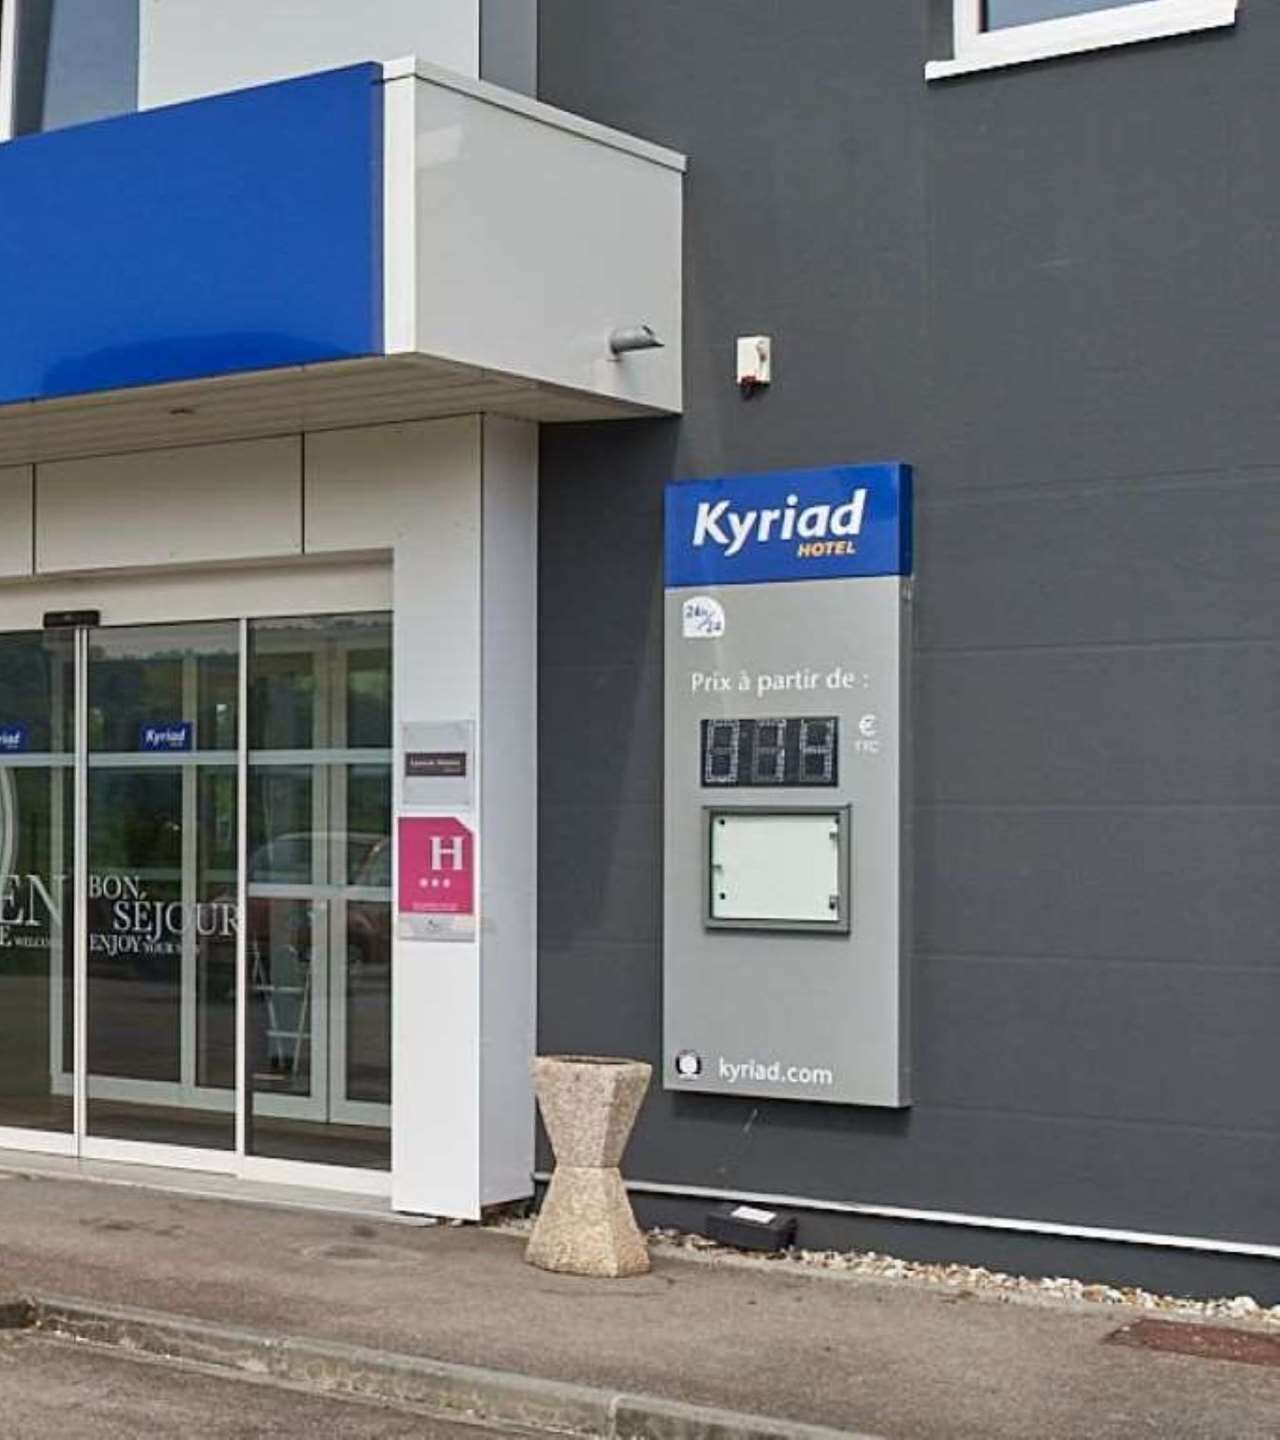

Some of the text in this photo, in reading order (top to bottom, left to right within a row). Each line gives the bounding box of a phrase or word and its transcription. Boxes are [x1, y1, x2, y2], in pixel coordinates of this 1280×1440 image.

[692, 488, 867, 557] Kyriad
[797, 541, 856, 557] HOTEL
[691, 672, 732, 692] Prix
[738, 670, 751, 691] à
[757, 669, 820, 698] partir
[825, 667, 855, 689] de
[430, 836, 464, 870] H
[90, 874, 140, 900] BON
[90, 933, 142, 957] ENJOY
[719, 1057, 833, 1085] kyriad.com
